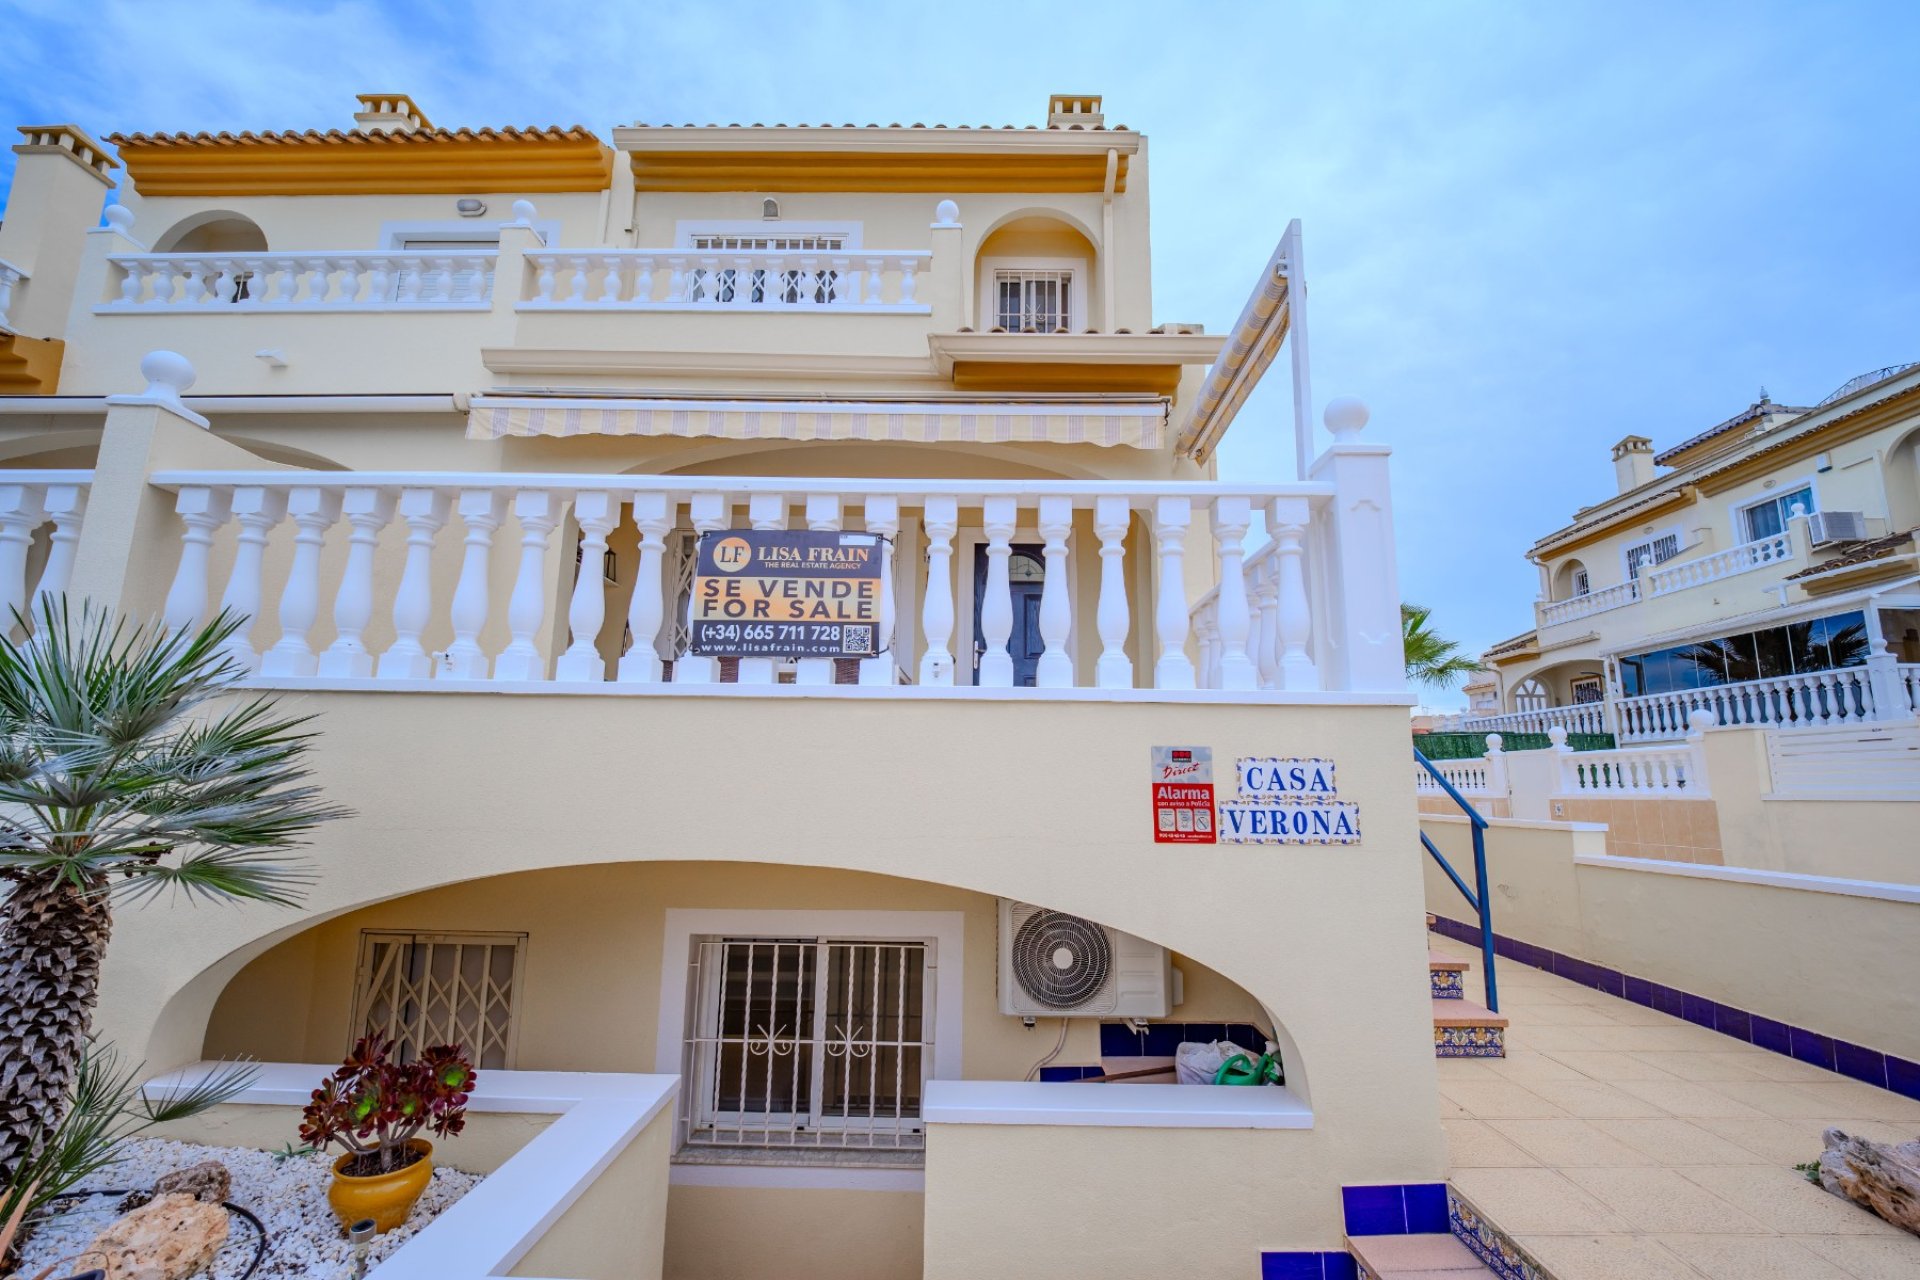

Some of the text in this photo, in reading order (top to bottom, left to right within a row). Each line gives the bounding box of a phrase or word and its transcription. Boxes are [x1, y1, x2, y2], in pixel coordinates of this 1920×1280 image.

[720, 546, 745, 563] LF
[758, 546, 869, 561] LISA FRAIN
[703, 578, 873, 599] SE VENDE
[702, 598, 873, 619] FOR SALE
[701, 624, 841, 642] (+34) 665 711 728
[701, 643, 840, 653] www.lisafrain.com
[1246, 766, 1330, 792] CASA
[1157, 786, 1210, 800] Alarma
[1226, 809, 1354, 835] VERONA
